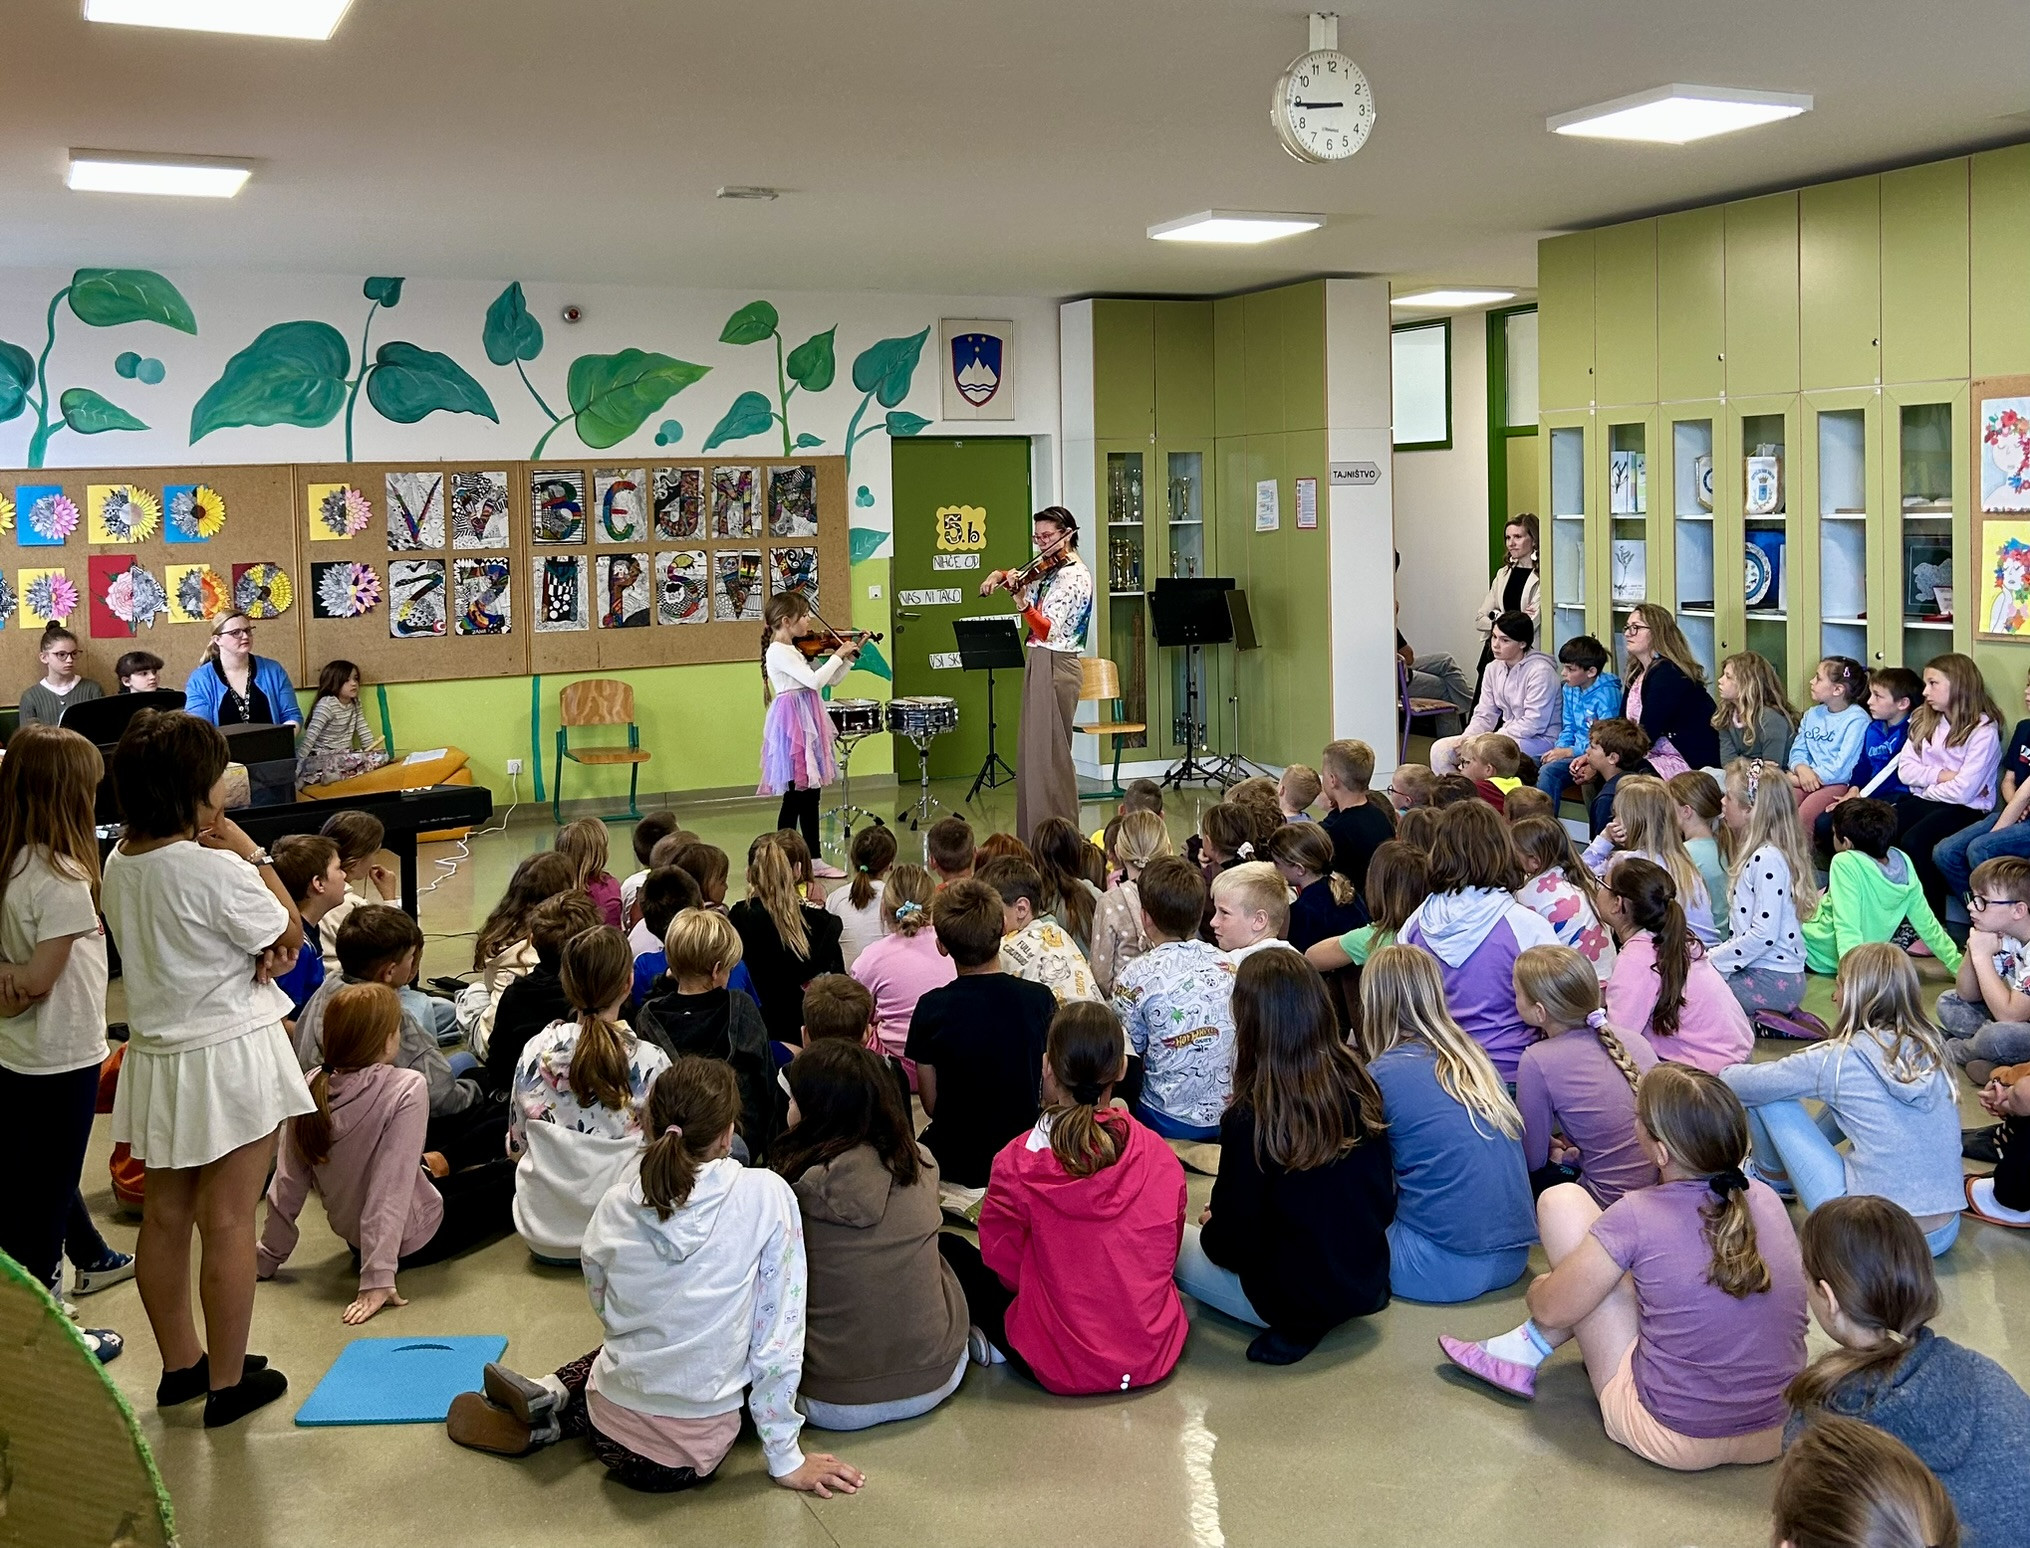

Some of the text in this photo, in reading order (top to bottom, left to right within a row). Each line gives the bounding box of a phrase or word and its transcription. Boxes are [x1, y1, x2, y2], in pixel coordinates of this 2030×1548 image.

[1312, 64, 1319, 76] 11
[1327, 60, 1337, 73] 12
[1344, 69, 1348, 80] 1
[1300, 75, 1309, 88] 10
[1354, 84, 1361, 95] 2
[1359, 104, 1365, 116] 3
[1299, 117, 1305, 129] 8
[1353, 123, 1359, 134] 4
[1311, 132, 1317, 143] 7
[1342, 136, 1348, 147] 5
[1327, 139, 1333, 150] 6
[1333, 469, 1376, 479] TAJNIŠTVO
[964, 555, 979, 569] OD
[937, 589, 960, 604] TAKO
